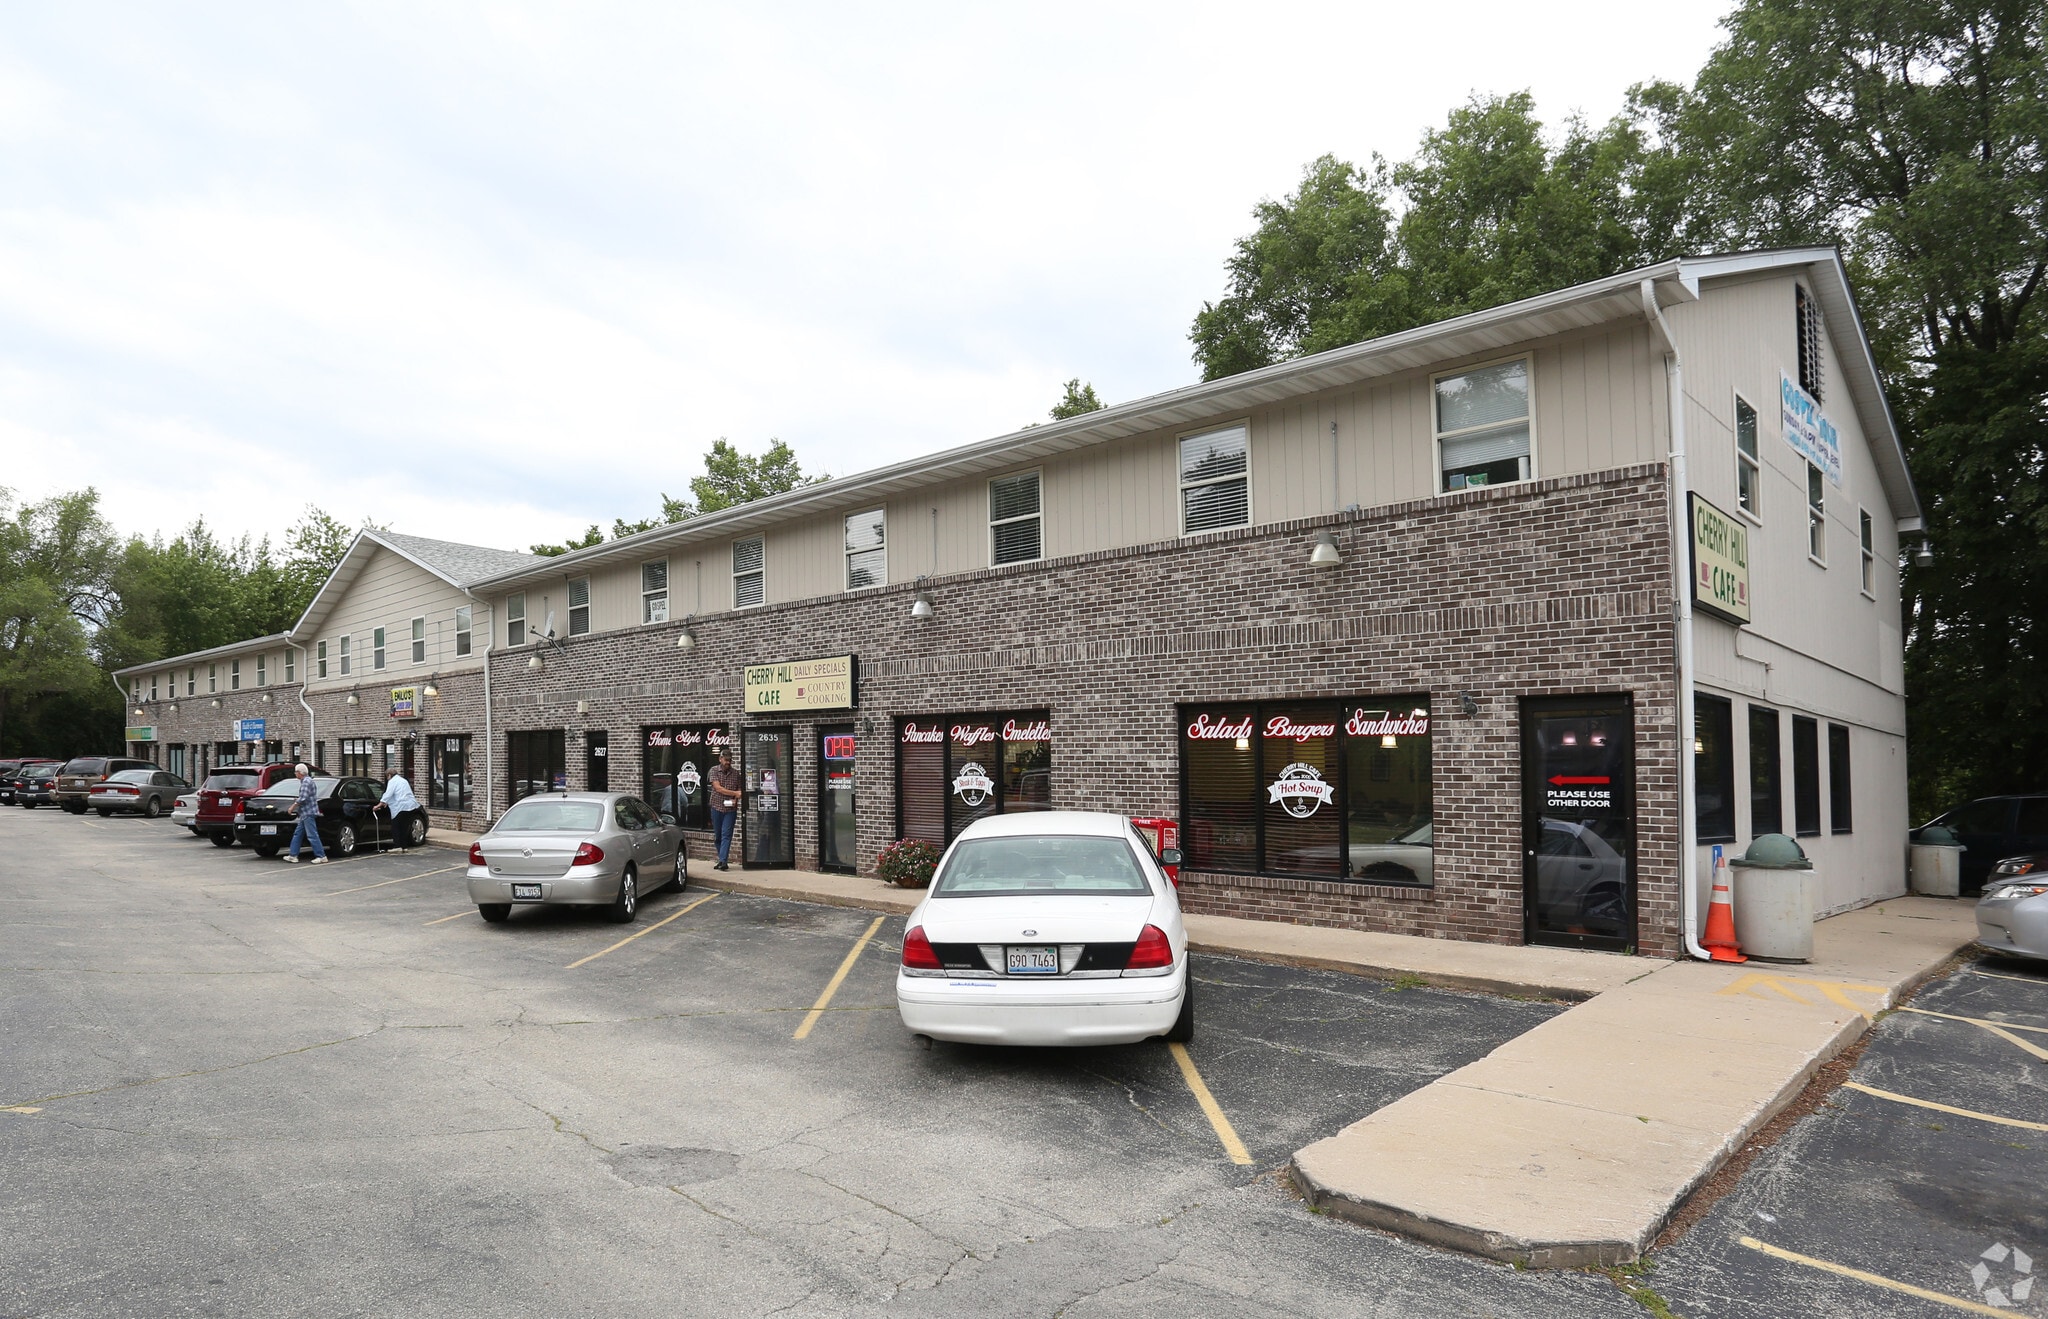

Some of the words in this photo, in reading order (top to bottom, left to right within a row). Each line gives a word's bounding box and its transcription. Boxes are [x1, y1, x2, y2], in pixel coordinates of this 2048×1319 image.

[1697, 505, 1728, 558] CHERRY
[1730, 526, 1745, 569] HILL
[1713, 566, 1736, 606] CAFE
[746, 667, 775, 685] CHERRY
[777, 666, 792, 683] HILL
[794, 665, 811, 677] DAILY
[814, 662, 846, 675] SPECIALS
[807, 681, 846, 693] COUNTRY
[758, 690, 780, 705] CAFE
[807, 693, 846, 704] COOKING
[902, 722, 944, 743] Pancakes
[950, 725, 995, 746] Waffles
[1002, 719, 1051, 741] Omelettes
[1187, 713, 1253, 739] Salads
[1263, 716, 1335, 742] Burgers
[1347, 708, 1428, 736] Sandwiches
[648, 730, 672, 746] Home
[675, 729, 701, 746] Style
[758, 733, 779, 742] 2635
[1278, 762, 1297, 778] CHERRY
[1297, 762, 1308, 770] HILL
[1308, 765, 1322, 778] CAFE
[1278, 783, 1297, 794] Hot
[1298, 781, 1323, 795] Soup
[1547, 790, 1587, 798] PLEASE
[1588, 790, 1611, 799] USE
[1547, 799, 1580, 807] OTHER
[1580, 799, 1611, 808] DOOR
[1009, 954, 1027, 968] G90
[1032, 954, 1056, 968] 7463
